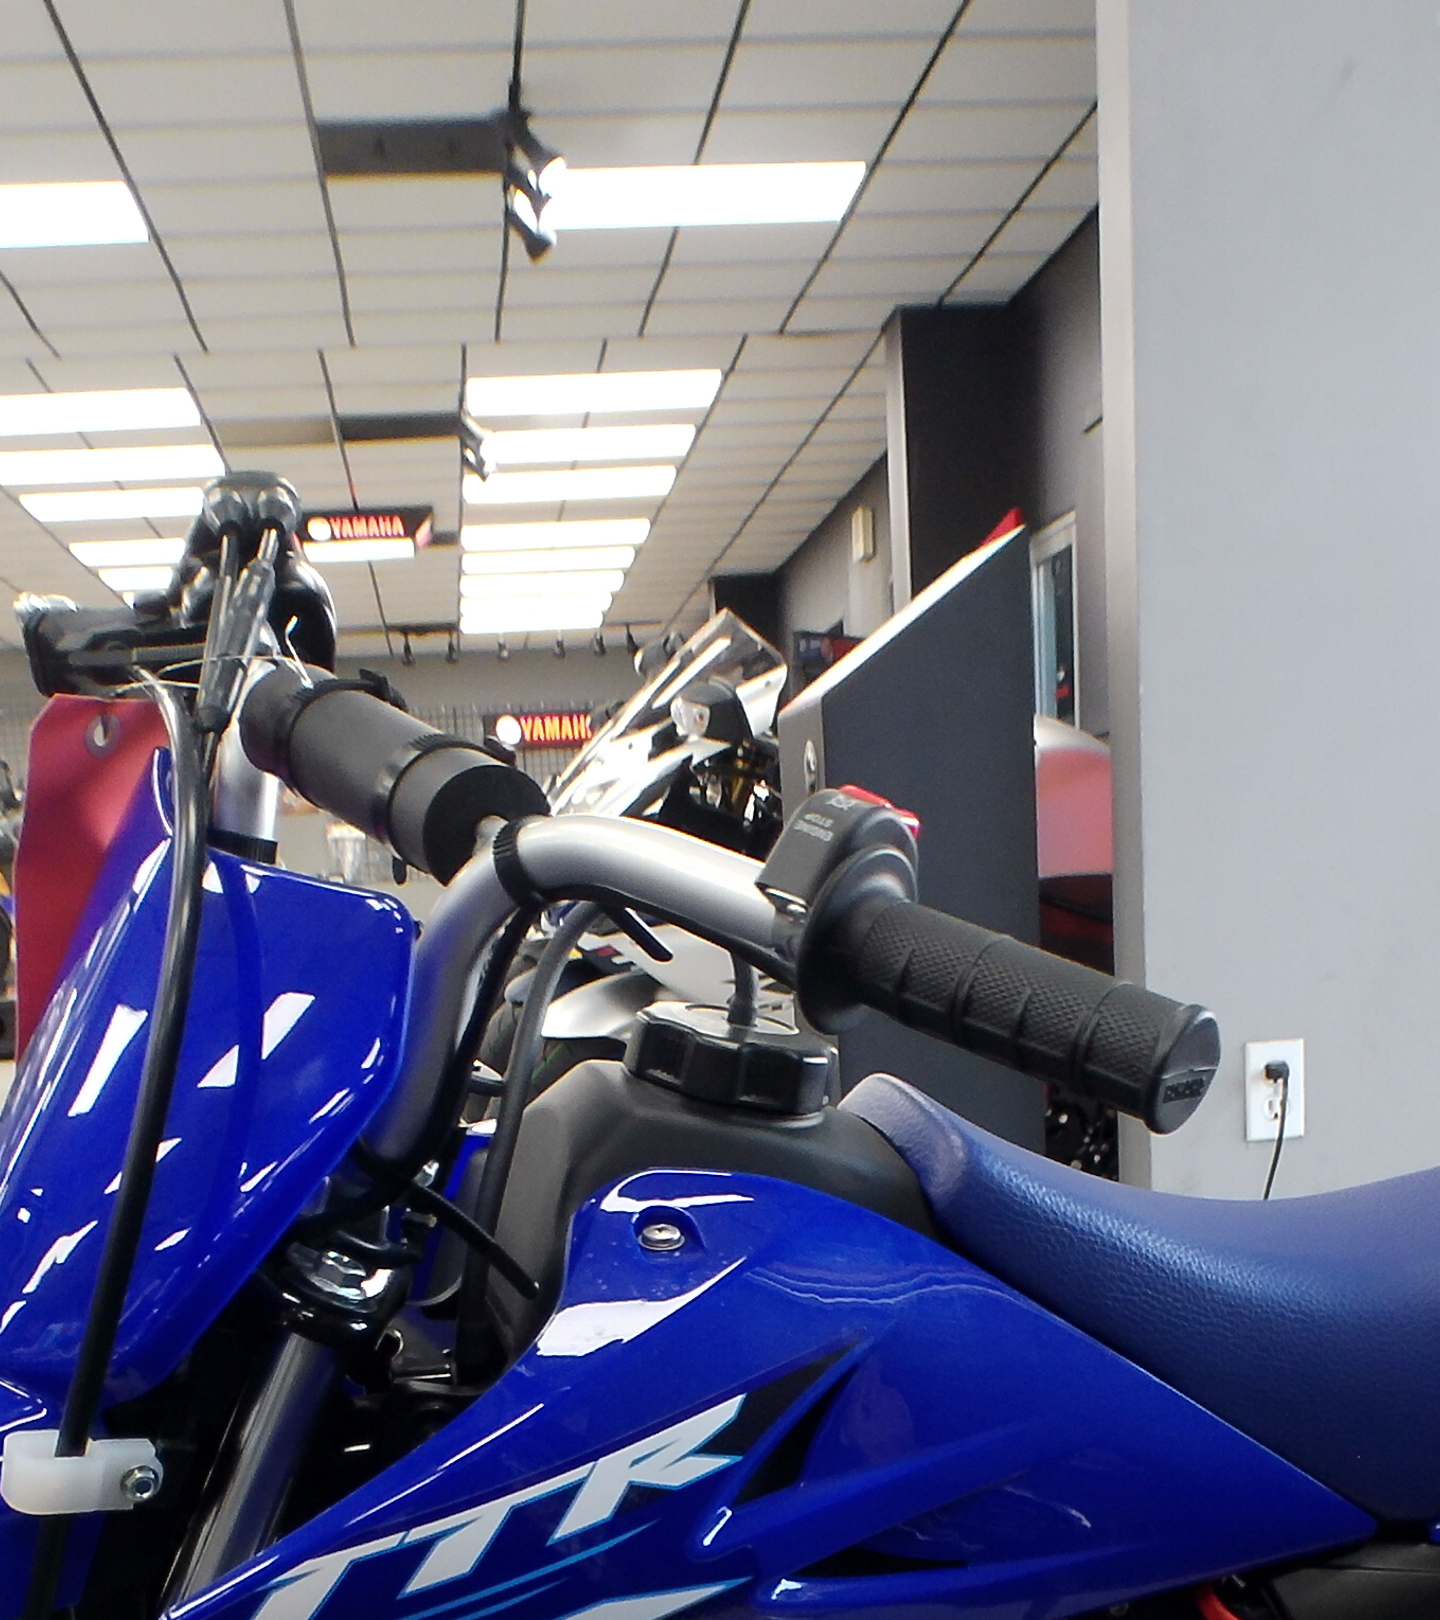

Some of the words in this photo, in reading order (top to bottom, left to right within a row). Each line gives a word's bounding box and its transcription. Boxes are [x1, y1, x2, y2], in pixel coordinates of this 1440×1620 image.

[328, 514, 405, 539] YAMAHA
[793, 819, 834, 842] ENGINE
[804, 811, 834, 828] STOP
